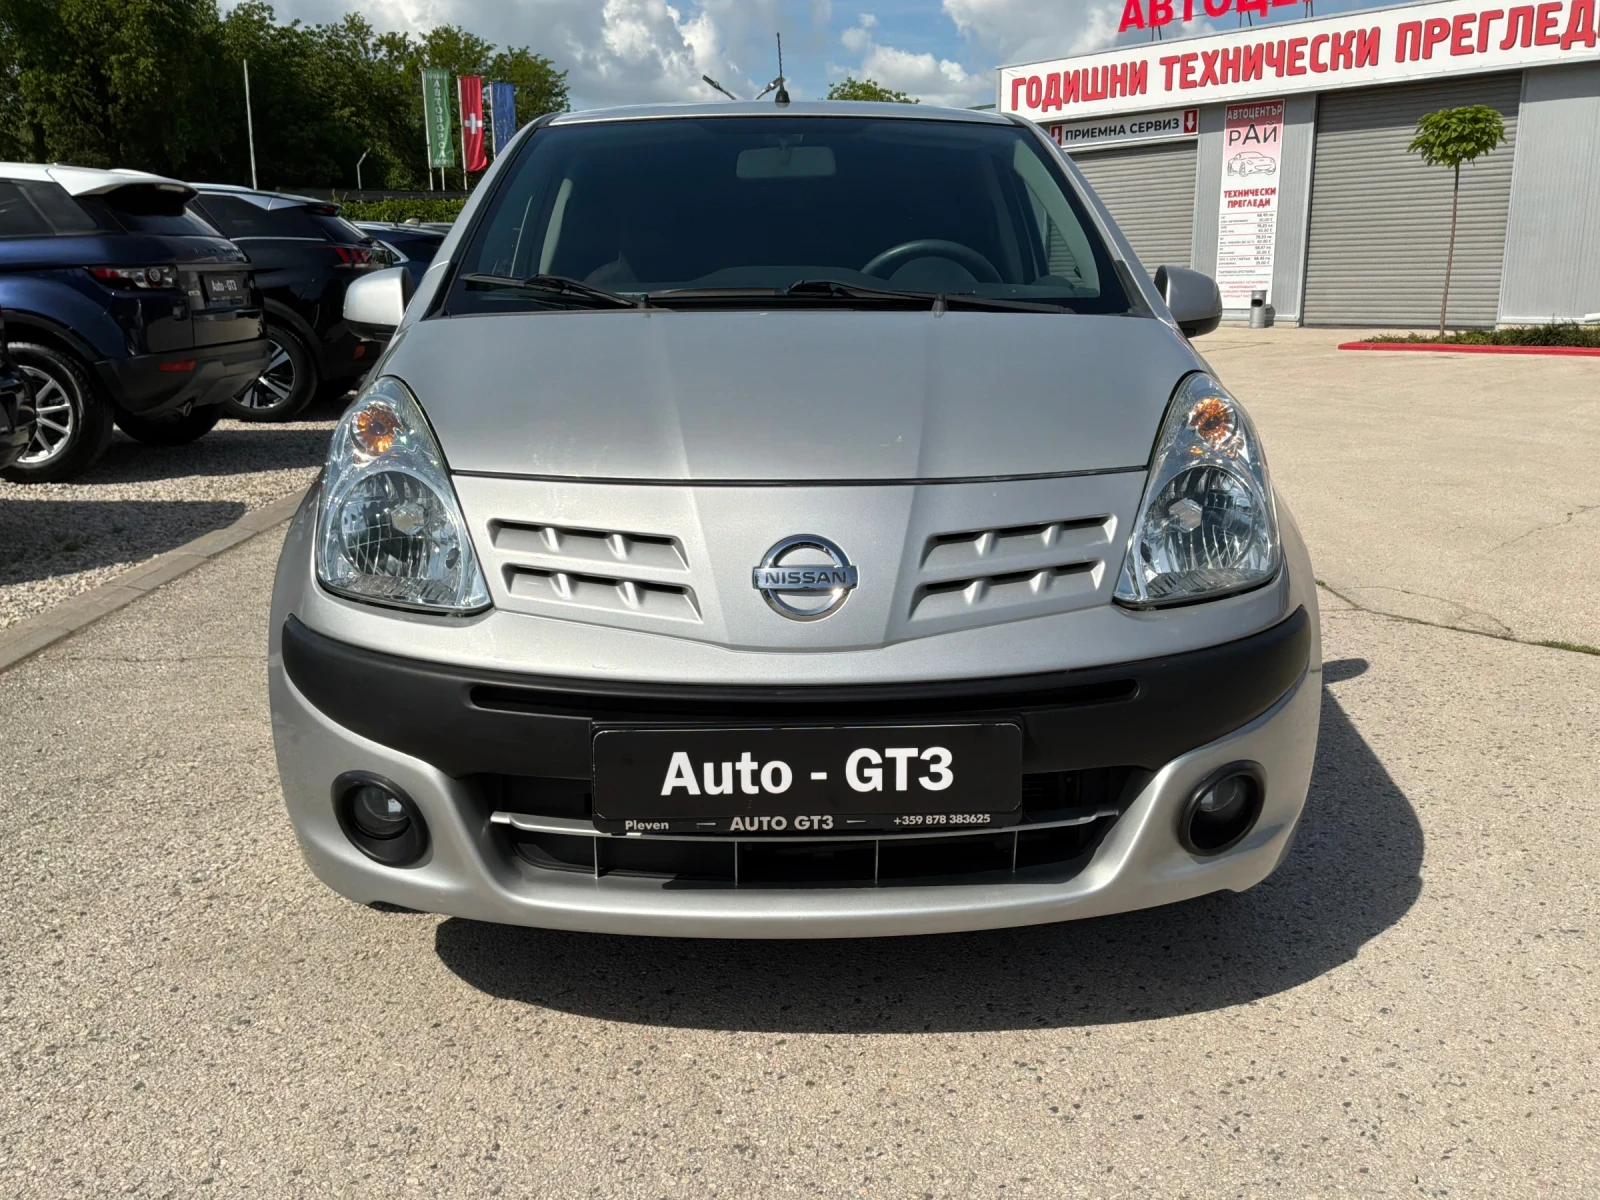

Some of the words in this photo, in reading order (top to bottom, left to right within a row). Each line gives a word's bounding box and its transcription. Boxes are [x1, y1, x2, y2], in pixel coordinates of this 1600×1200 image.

[1011, 60, 1148, 112] ГОДИШНИ
[1160, 26, 1381, 91] ТЕХНИЧЕСКИ
[1395, 0, 1600, 63] ПРЕГЛЕД
[1227, 105, 1282, 120] АВТОЦЕНТЪР
[1065, 123, 1126, 141] ПРИЕМНА
[1130, 118, 1180, 135] СЕРВИЗ
[1228, 121, 1278, 147] РАЙ
[1223, 187, 1276, 198] ТЕХНИЧЕСКИ
[1227, 198, 1271, 208] ПРЕГЛЕДИ
[765, 571, 848, 585] NISSAN
[660, 751, 793, 796] Auto
[845, 747, 954, 792] GT3
[625, 819, 669, 830] Pleven
[730, 815, 788, 831] AUTO
[794, 815, 834, 830] GT3
[893, 815, 923, 826] +359
[925, 814, 947, 825] 878
[949, 813, 991, 824] 383625
